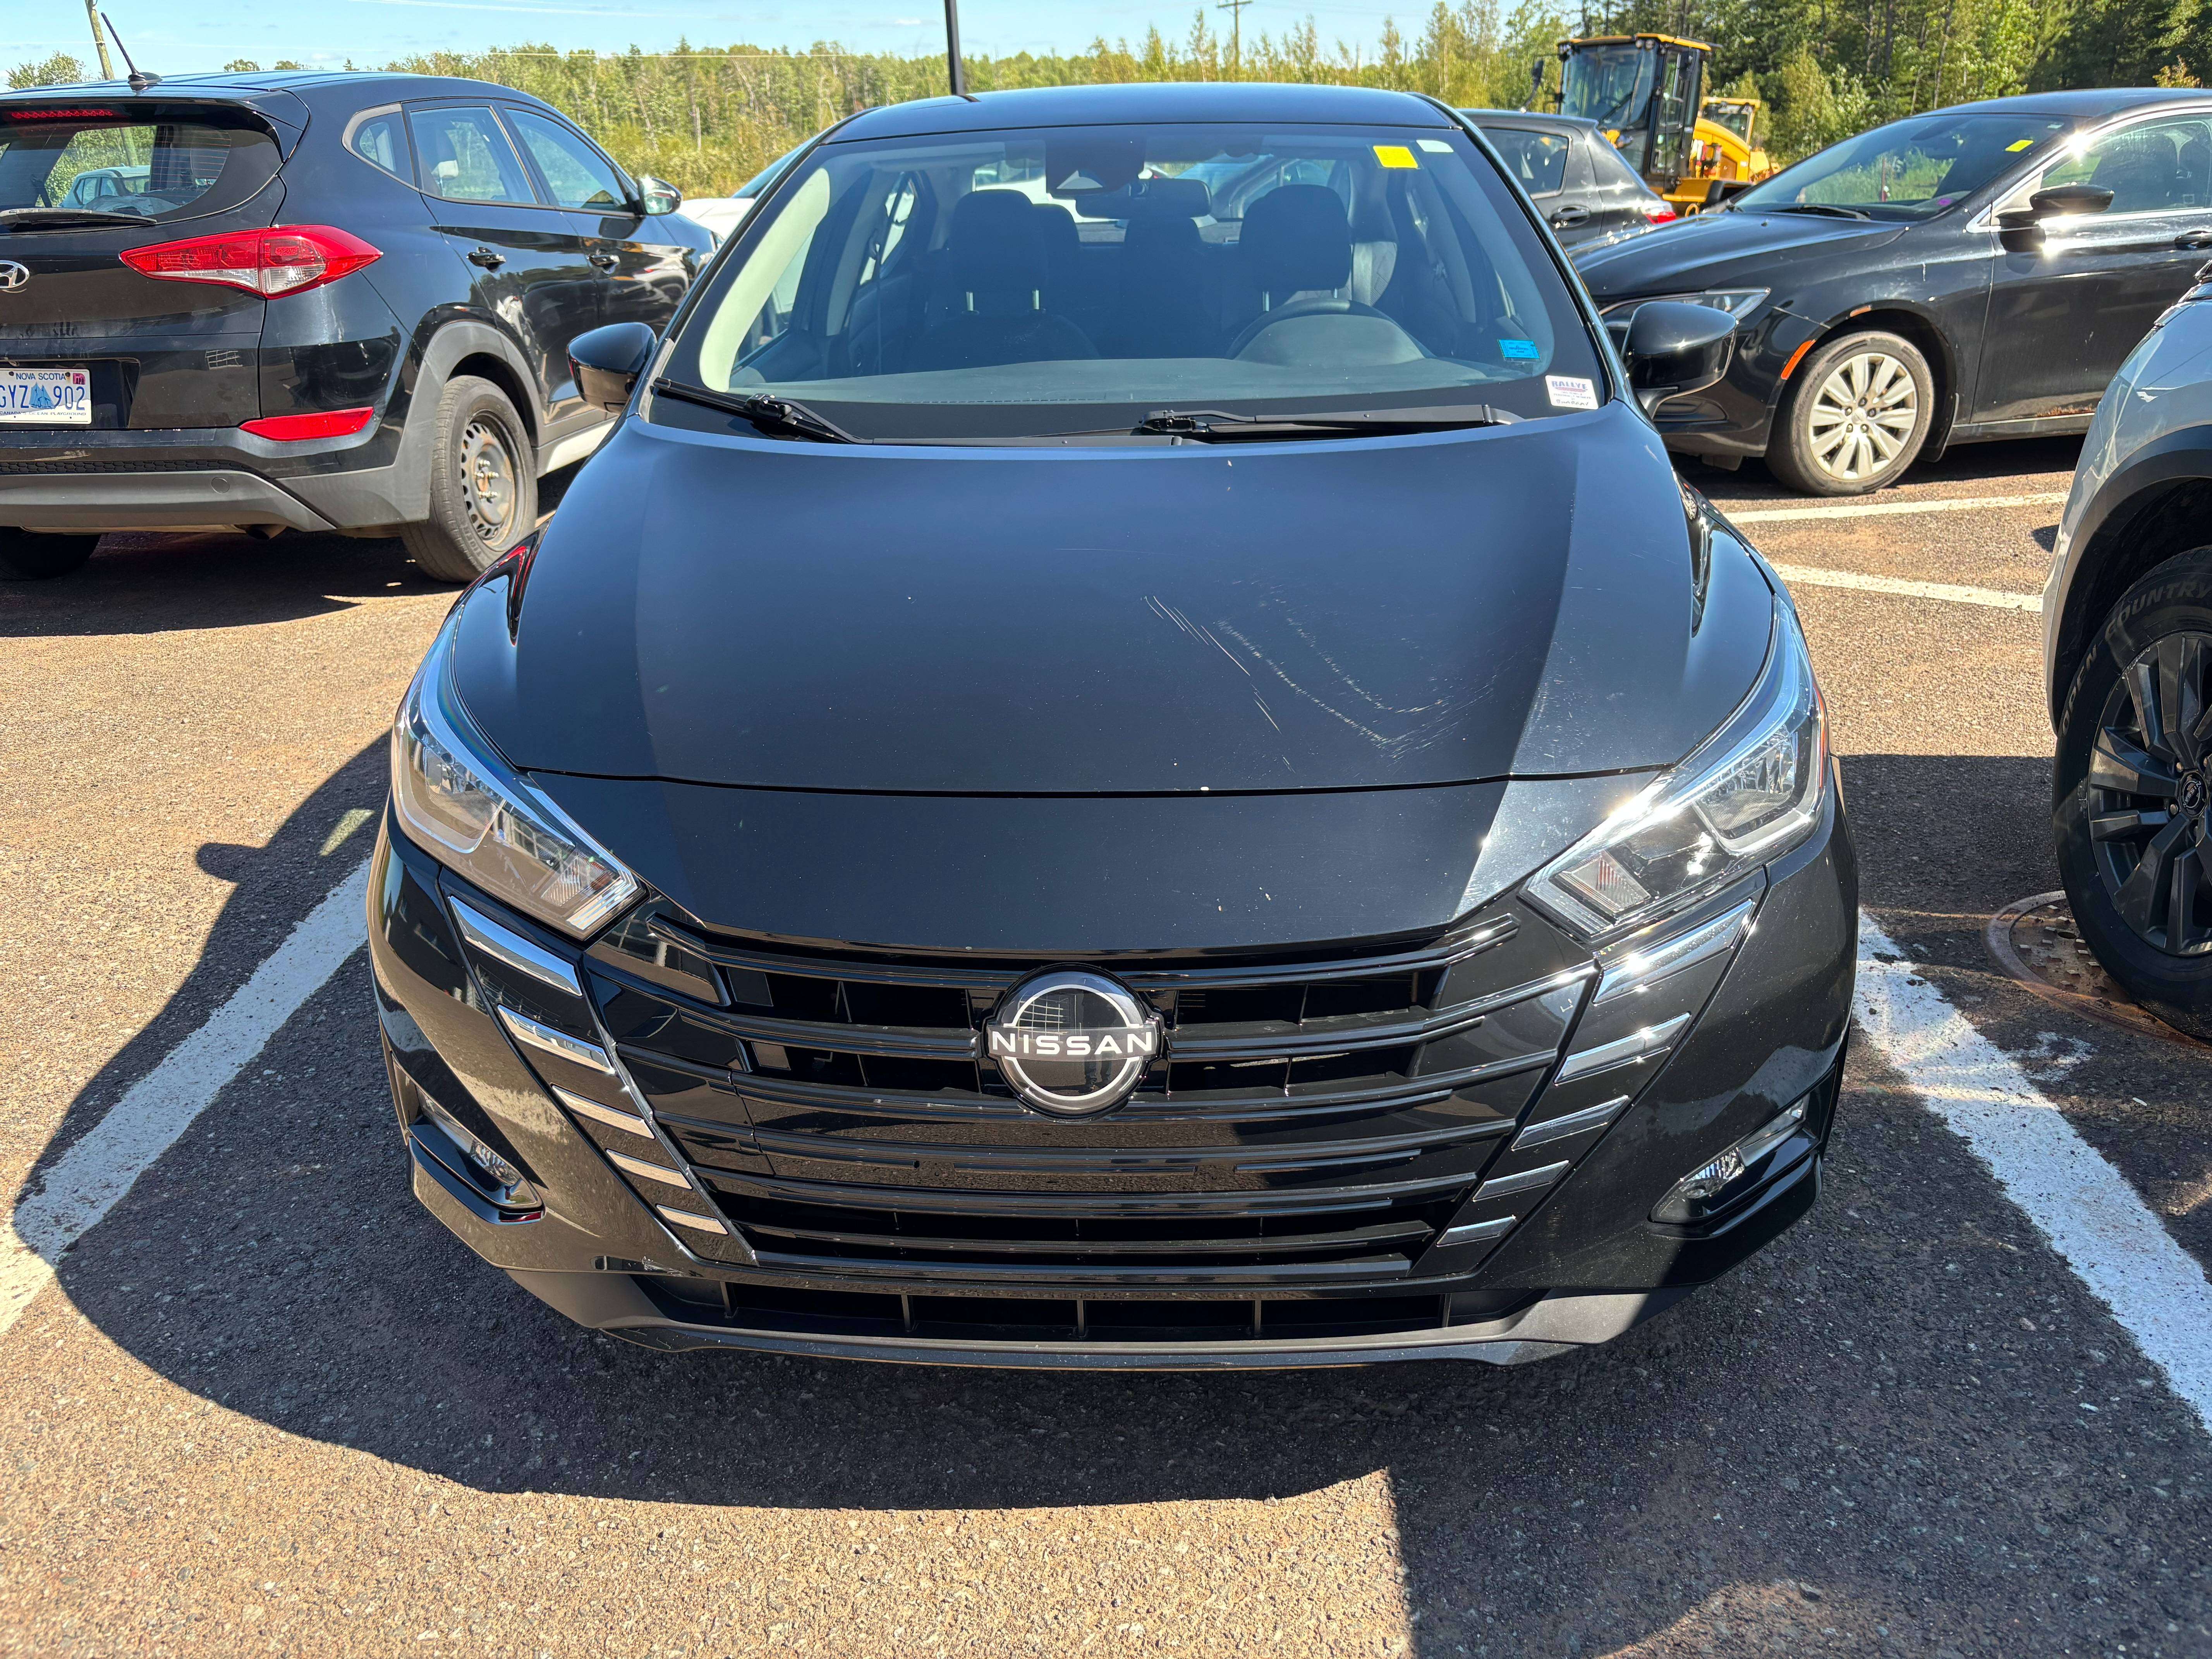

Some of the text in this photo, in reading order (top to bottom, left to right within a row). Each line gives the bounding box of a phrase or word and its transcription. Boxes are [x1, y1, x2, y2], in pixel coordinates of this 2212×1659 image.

[0, 385, 85, 410] GYZ 902
[1551, 381, 1588, 390] RALLYE
[2063, 580, 2212, 735] OPEN COUNTRY
[2183, 781, 2202, 808] NISSAN
[992, 1031, 1152, 1056] NISSAN
